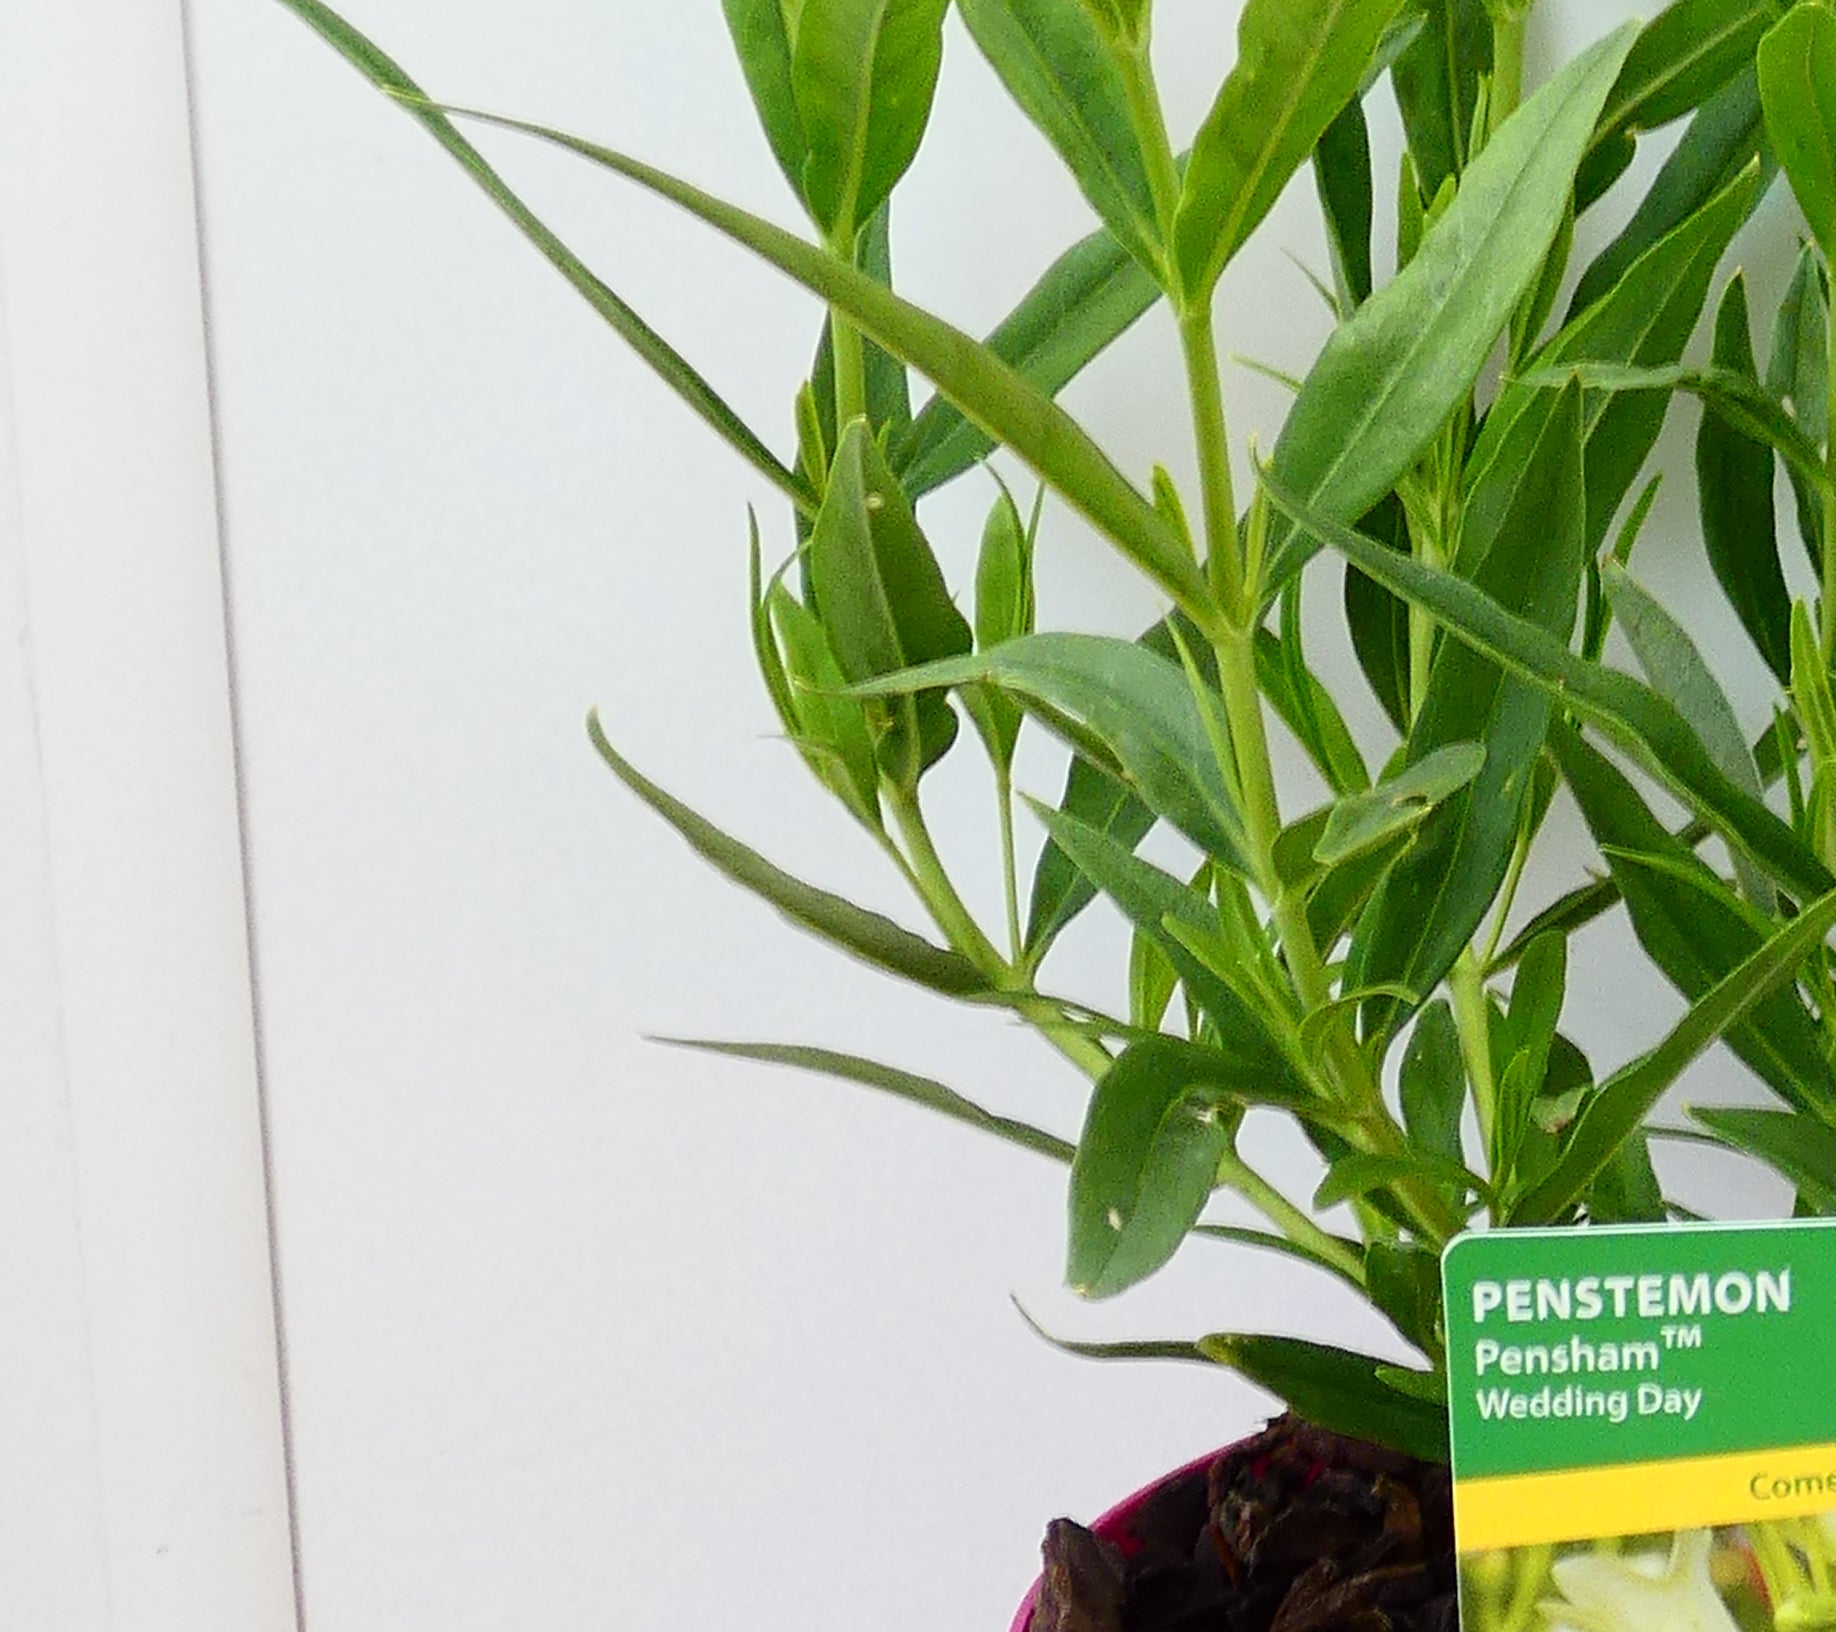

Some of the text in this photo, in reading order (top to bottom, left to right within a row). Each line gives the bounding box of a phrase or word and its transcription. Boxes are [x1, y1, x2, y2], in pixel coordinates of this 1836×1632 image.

[1472, 1267, 1792, 1324] PENSTEMON
[1475, 1381, 1702, 1424] Wedding Day
